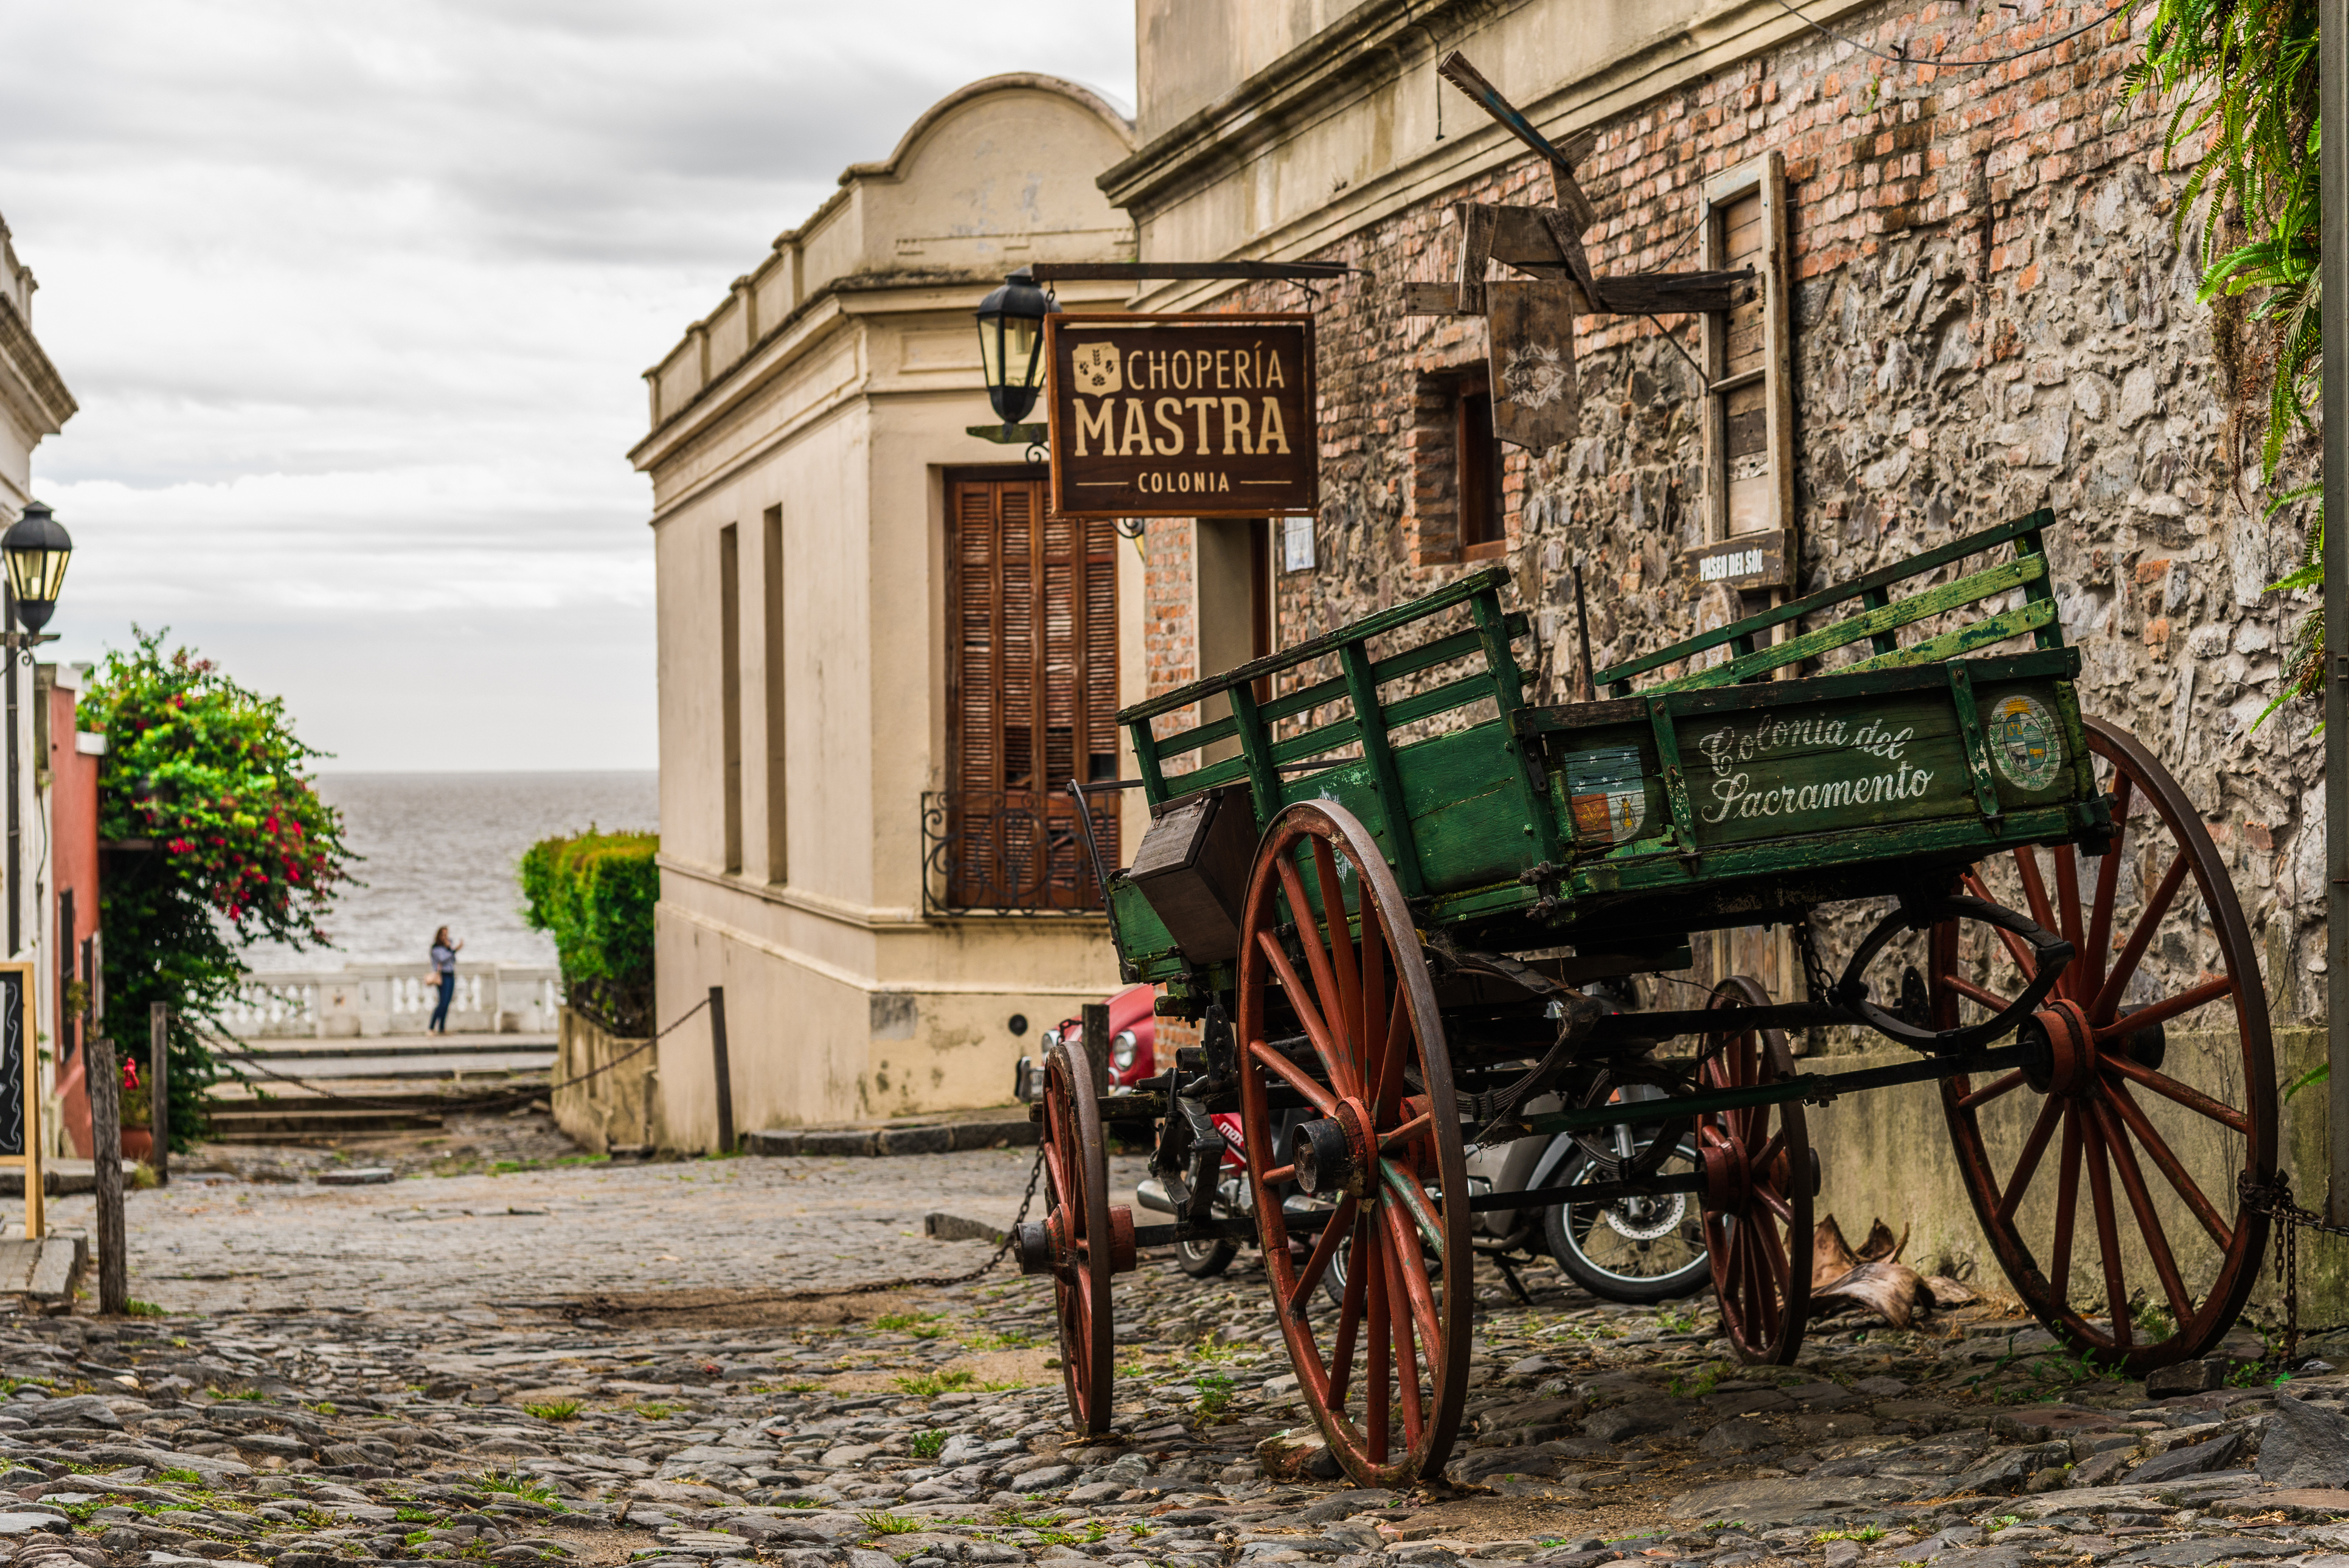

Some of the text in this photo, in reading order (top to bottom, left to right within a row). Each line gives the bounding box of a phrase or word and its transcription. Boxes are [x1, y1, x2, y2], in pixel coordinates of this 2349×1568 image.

[1127, 340, 1285, 390] CHOPERÍA
[1072, 397, 1291, 456] MASTRA
[1138, 472, 1229, 493] COLONIA
[1699, 548, 1763, 581] PASEO DEL SOL
[1699, 711, 1914, 776] Colonia del
[1701, 760, 1934, 824] Sacramento
